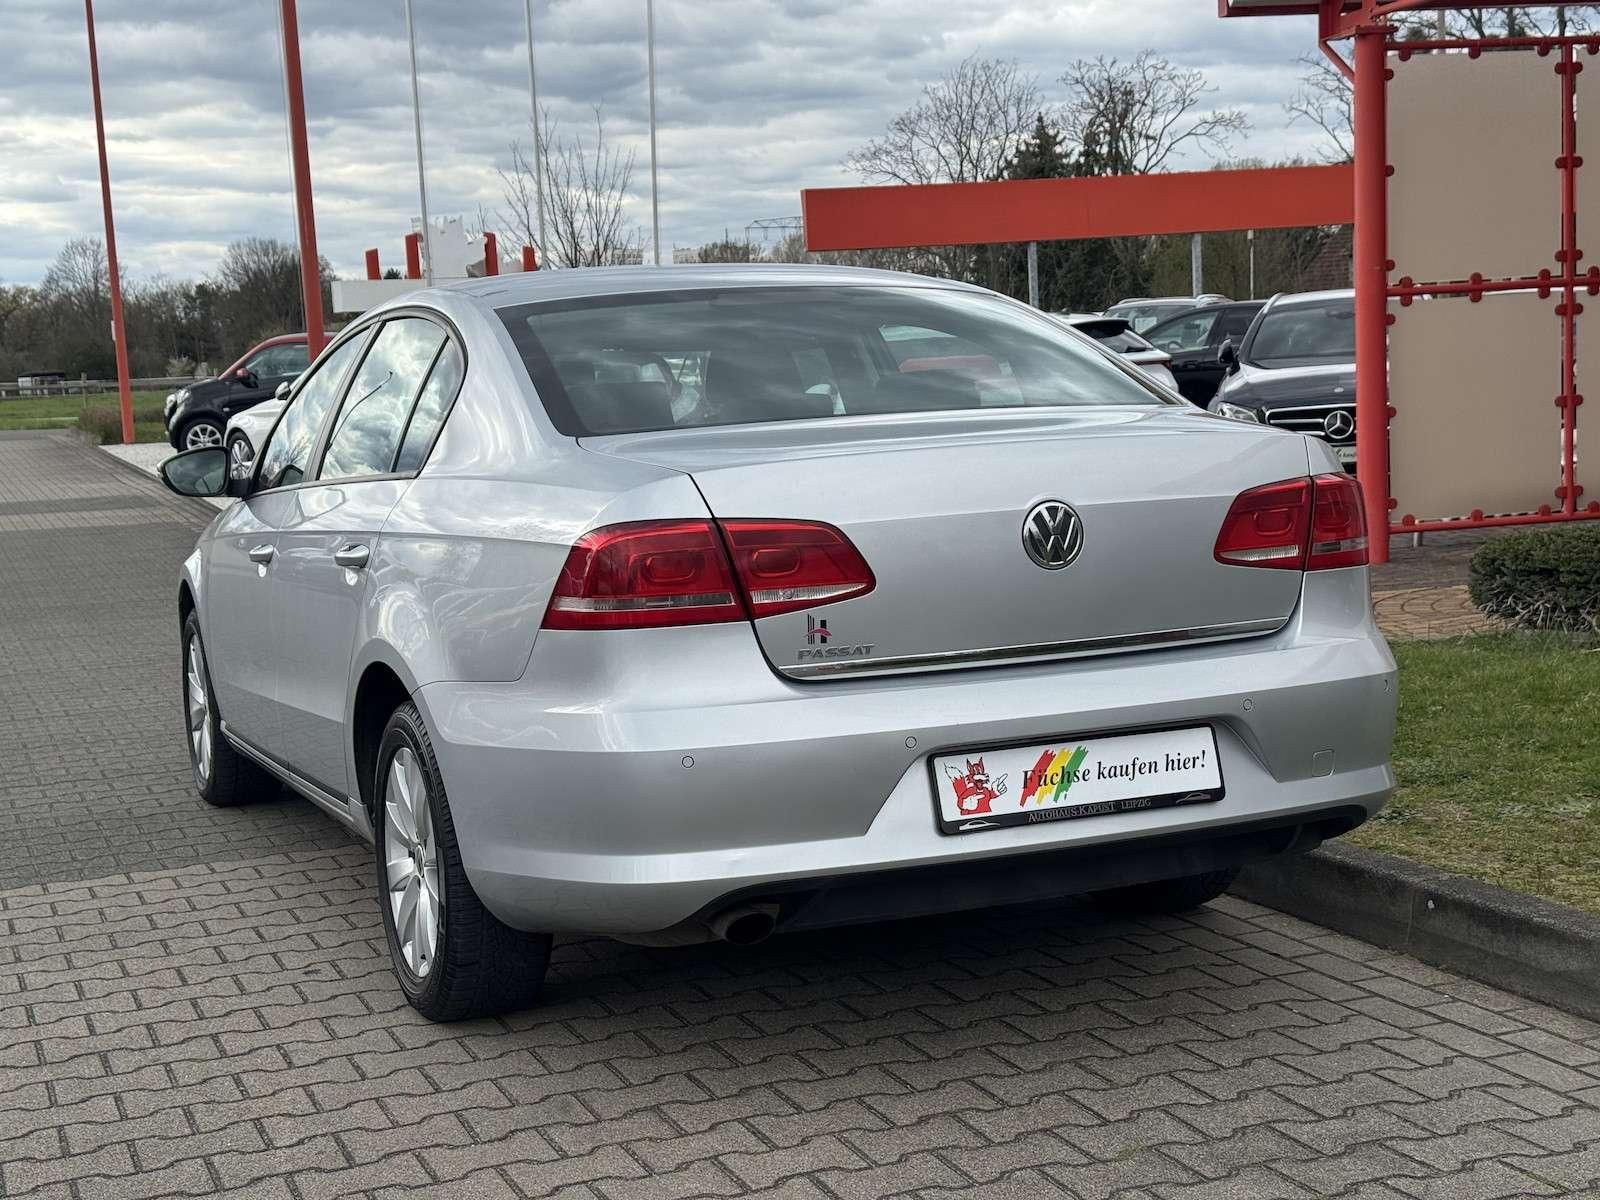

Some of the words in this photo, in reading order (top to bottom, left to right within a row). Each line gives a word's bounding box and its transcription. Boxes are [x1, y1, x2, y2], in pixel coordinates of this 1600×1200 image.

[798, 643, 875, 659] PASSAT
[1021, 766, 1090, 789] Füchse
[1096, 757, 1158, 781] kaufen
[1165, 750, 1206, 772] hier!
[1120, 798, 1151, 809] LEIPZIG
